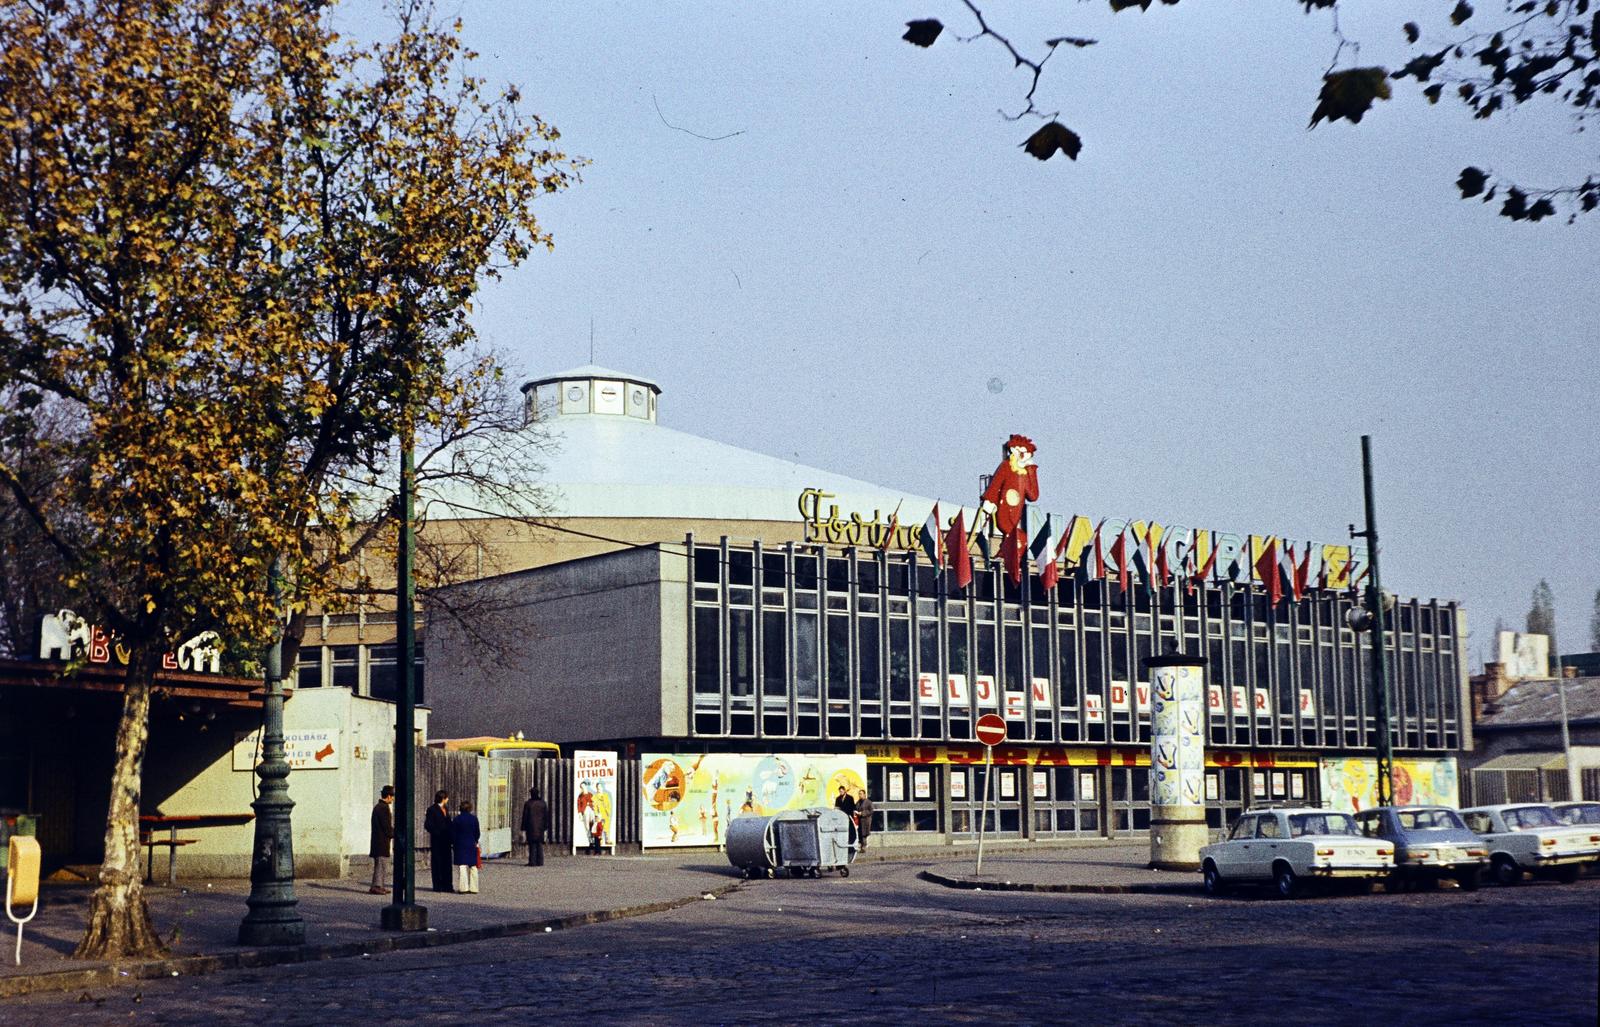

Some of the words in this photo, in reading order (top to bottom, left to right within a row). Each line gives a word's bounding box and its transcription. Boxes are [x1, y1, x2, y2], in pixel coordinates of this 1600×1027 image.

[919, 675, 1046, 716] ÉLJEN
[1086, 686, 1265, 718] NOVBER
[577, 768, 614, 779] ITTHON
